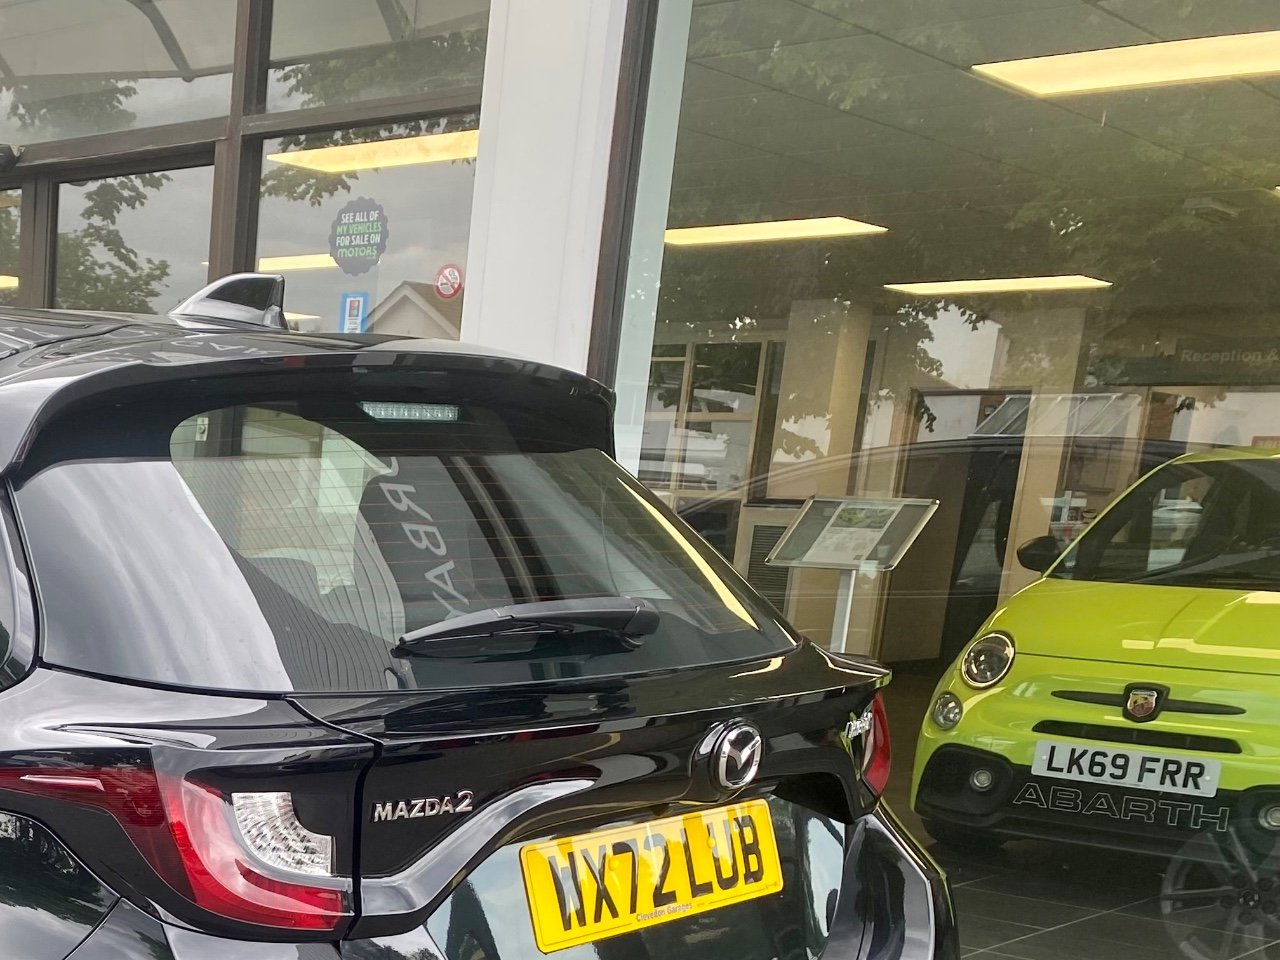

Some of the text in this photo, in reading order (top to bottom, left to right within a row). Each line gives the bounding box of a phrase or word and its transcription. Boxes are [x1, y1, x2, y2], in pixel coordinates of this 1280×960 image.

[336, 221, 382, 235] MY VEHICLES
[341, 210, 379, 223] SEE ALL OF
[336, 233, 381, 246] FOR SALE ON
[1180, 348, 1262, 365] Reception
[1046, 745, 1206, 790] LK69 FRR
[372, 789, 474, 823] MAZDA2
[1013, 782, 1230, 832] ABARTH
[680, 814, 764, 899] LUB
